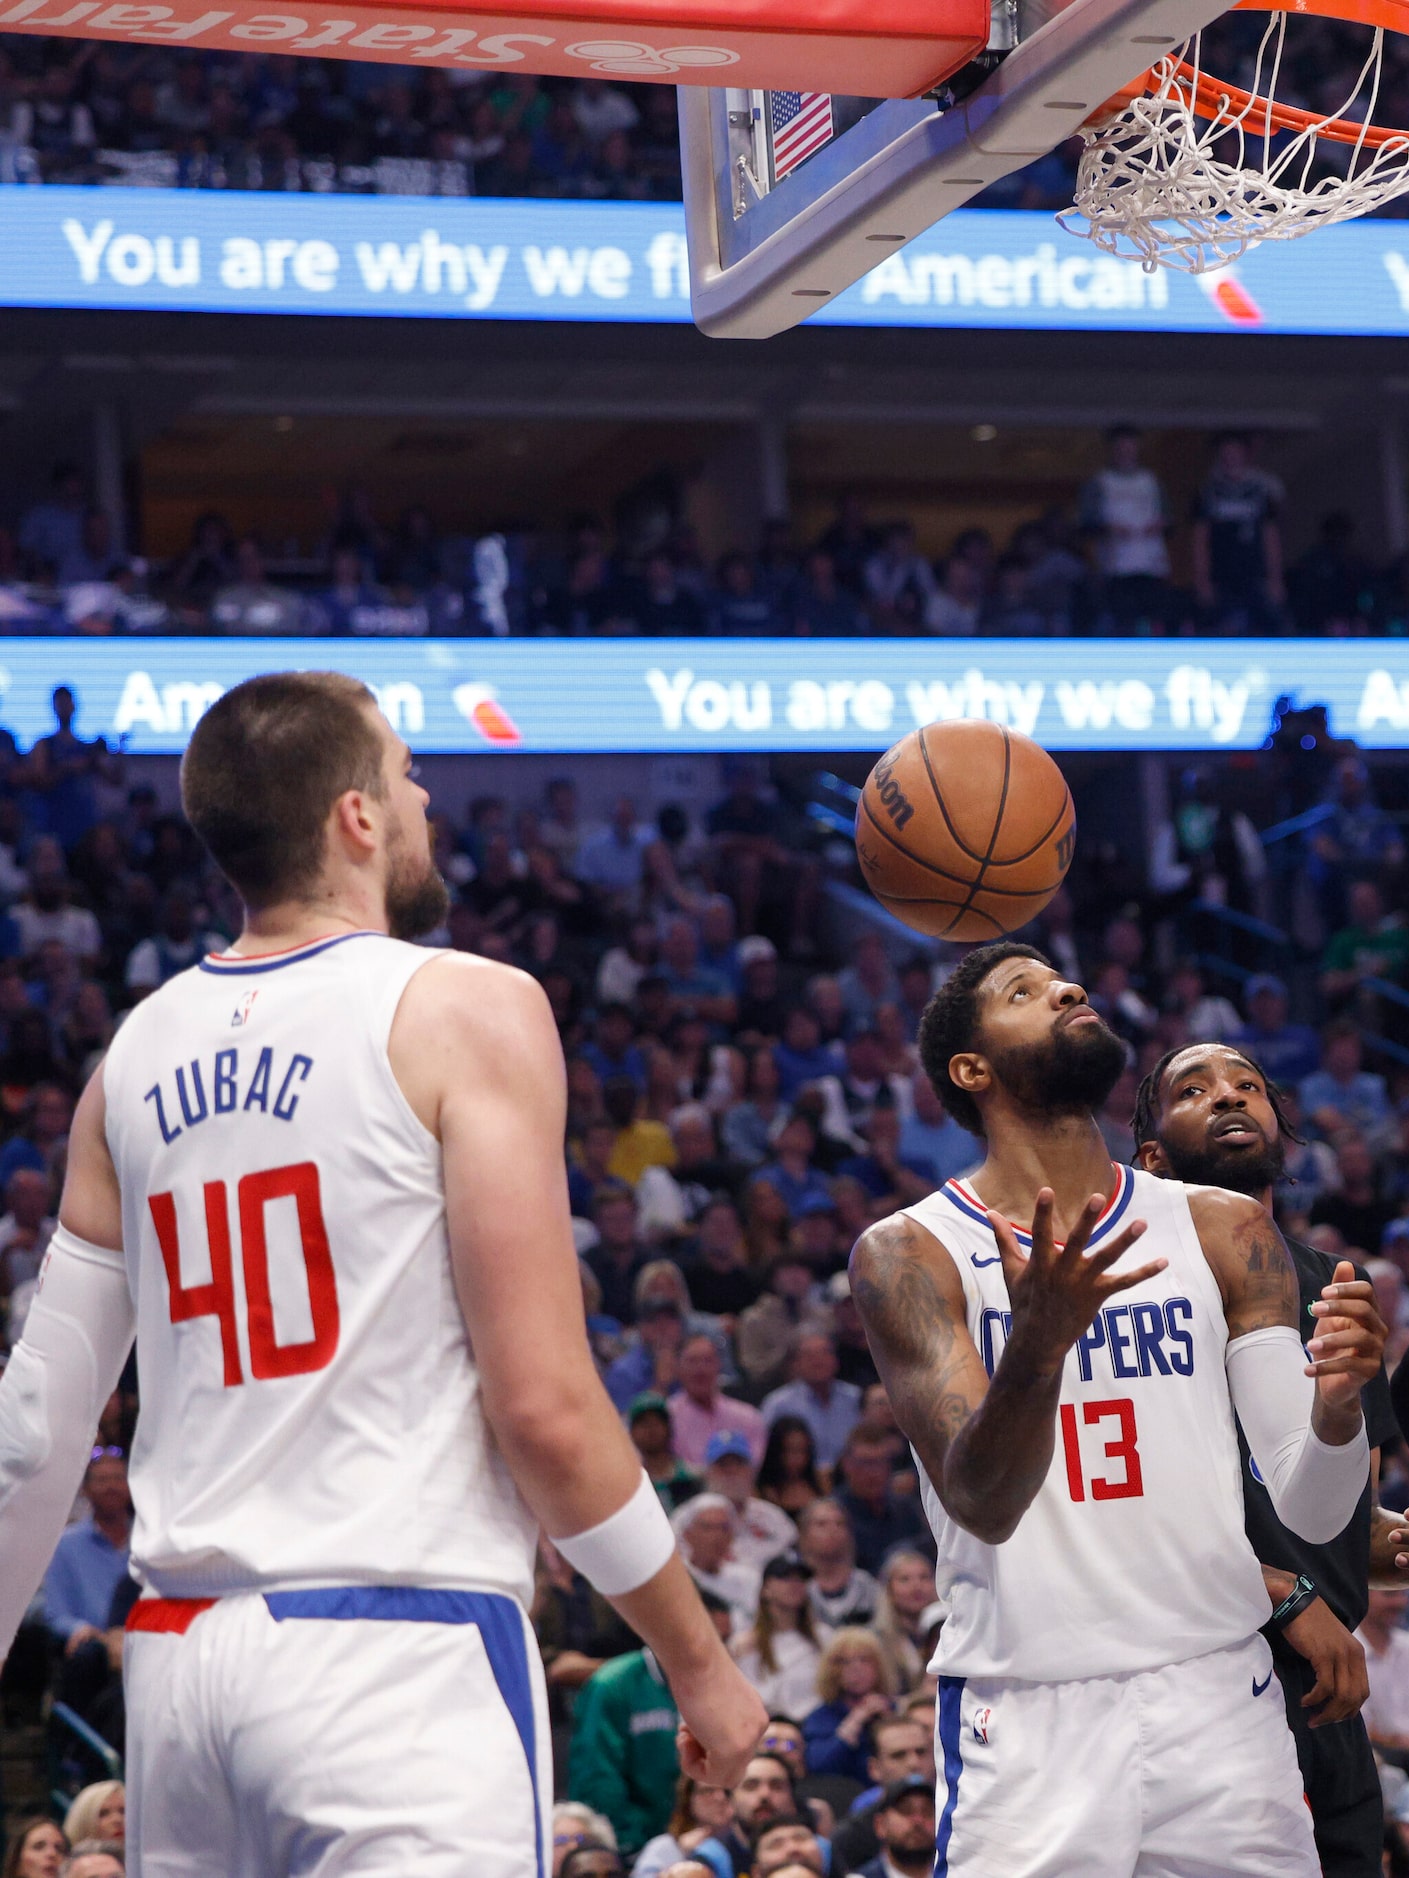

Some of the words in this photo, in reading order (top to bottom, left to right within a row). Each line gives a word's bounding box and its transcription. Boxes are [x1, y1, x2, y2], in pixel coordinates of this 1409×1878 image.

[229, 14, 556, 63] State
[62, 218, 200, 288] You
[219, 232, 340, 293] are
[355, 230, 509, 311] why
[522, 245, 631, 298] we
[645, 231, 690, 299] fl
[862, 244, 1168, 309] American
[645, 668, 772, 732] You
[785, 680, 894, 731] are
[905, 668, 1045, 735] why
[1054, 680, 1156, 730] we
[144, 1047, 313, 1145] ZUBAC
[148, 1161, 340, 1388] 40
[980, 1297, 1194, 1382] CPERS
[1059, 1398, 1144, 1503] 13
